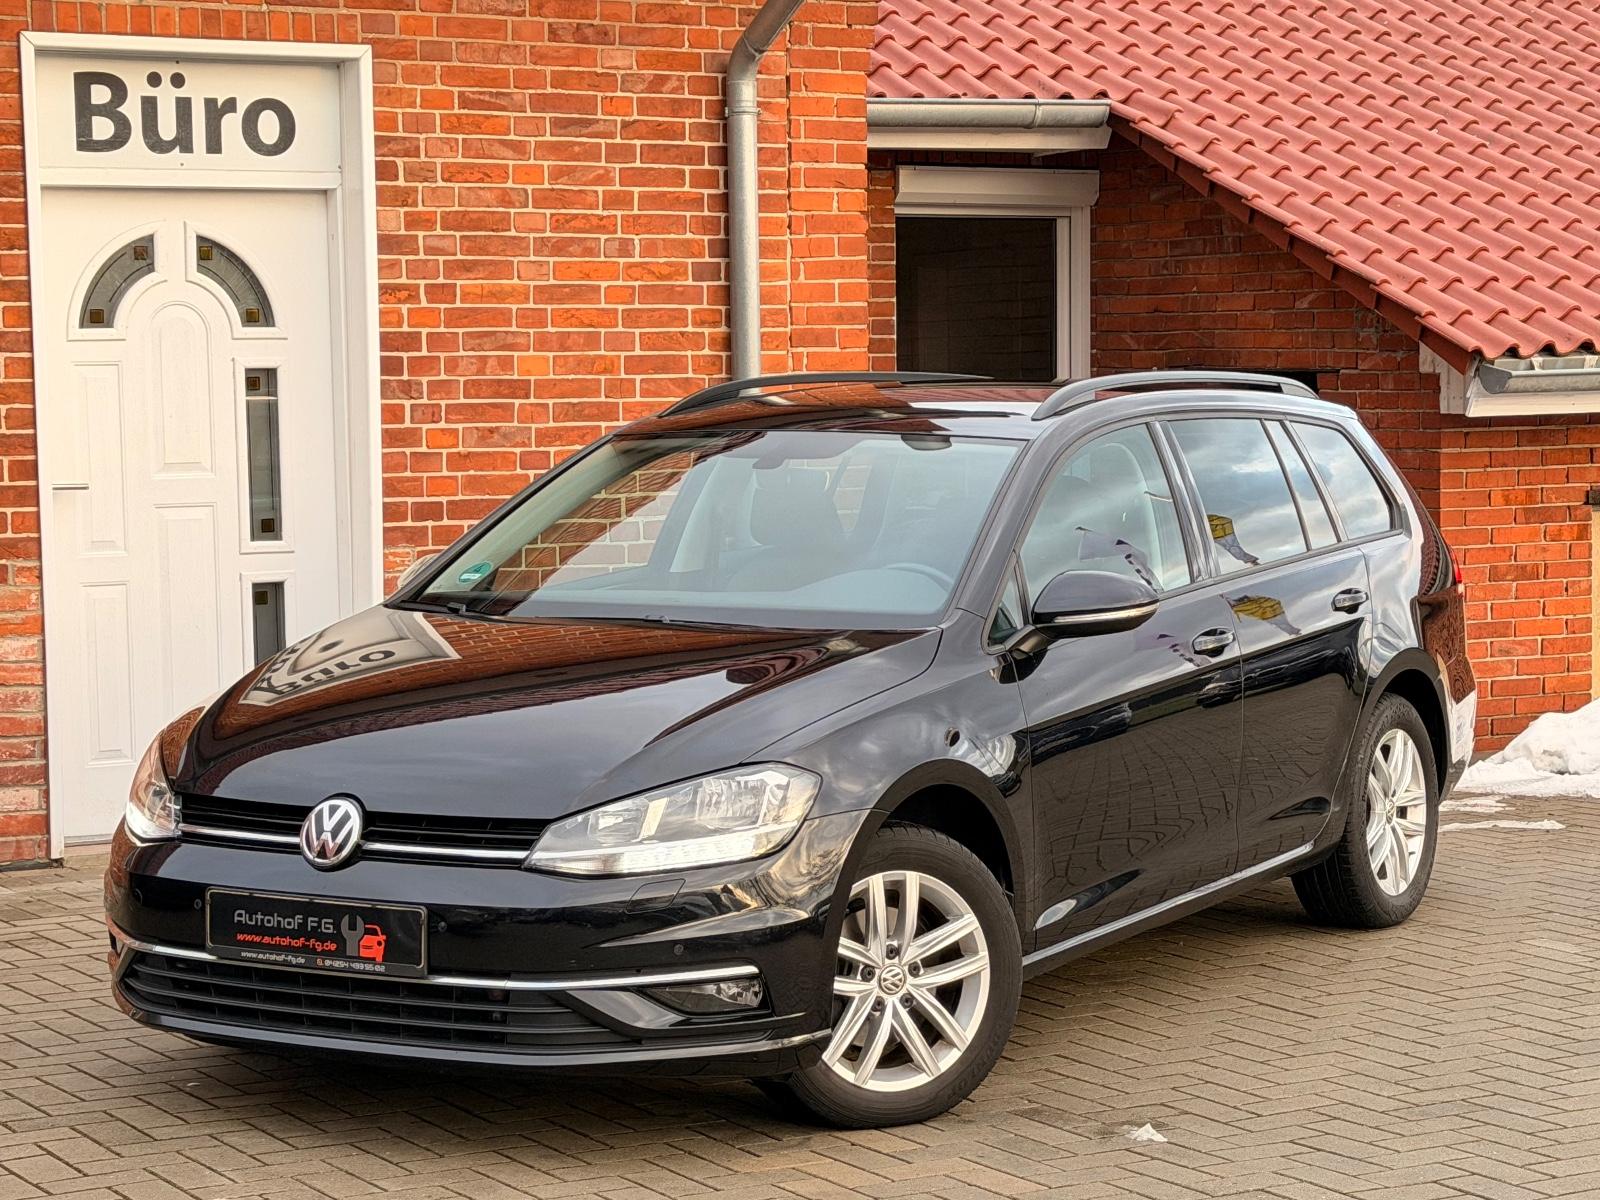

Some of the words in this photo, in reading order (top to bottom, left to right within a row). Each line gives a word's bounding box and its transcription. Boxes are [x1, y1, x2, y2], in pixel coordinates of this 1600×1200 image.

[73, 71, 296, 156] Büro
[300, 797, 363, 866] VW
[233, 909, 303, 930] Autohof
[307, 917, 337, 934] F.G.
[236, 932, 337, 952] www.autohof-fg.de
